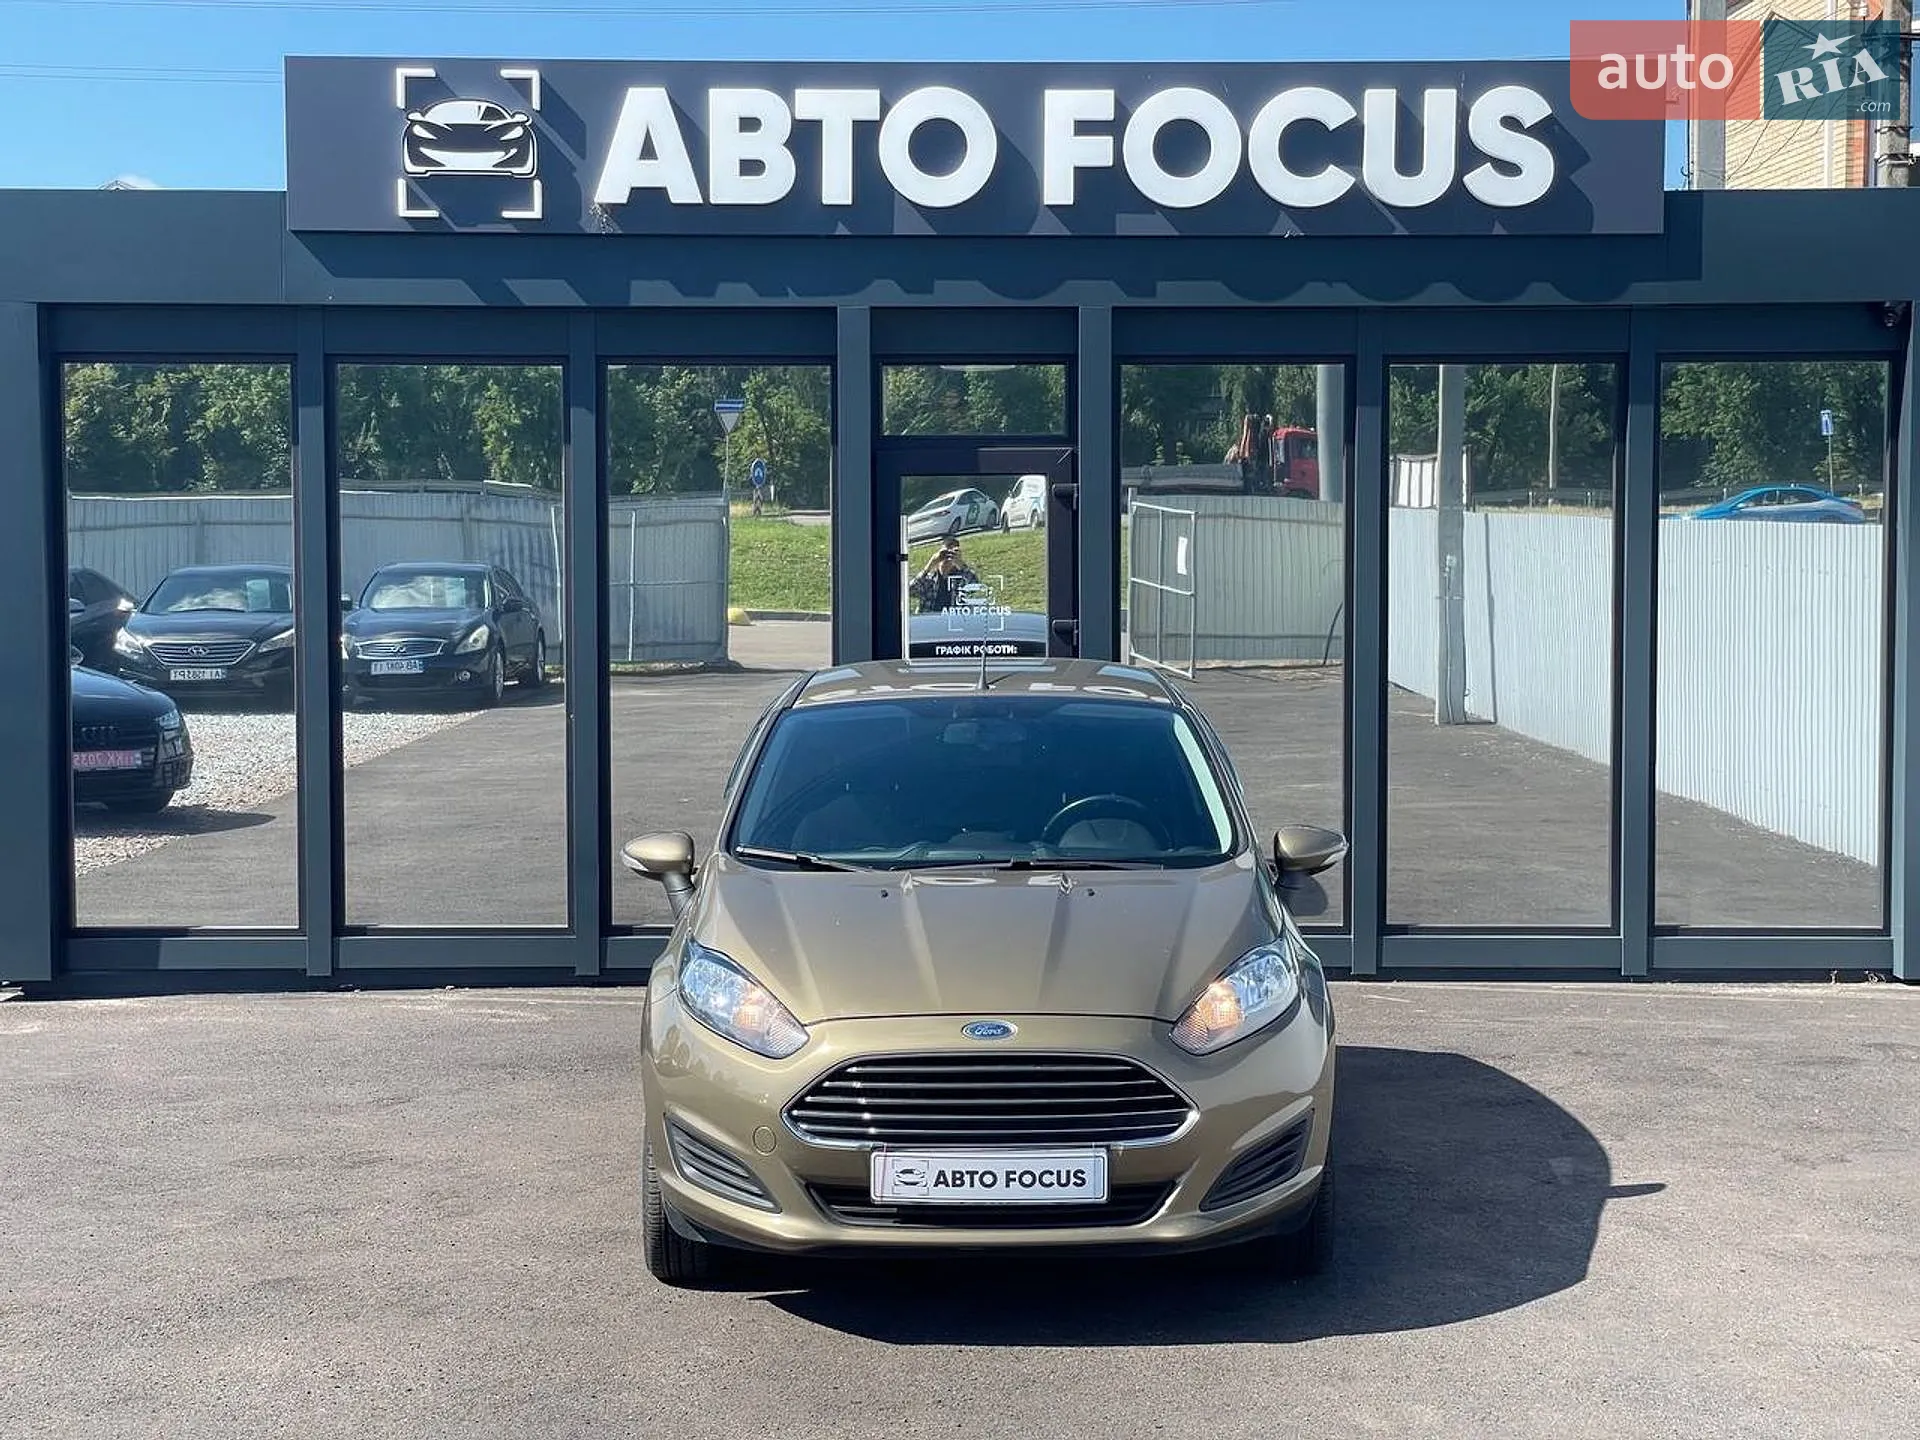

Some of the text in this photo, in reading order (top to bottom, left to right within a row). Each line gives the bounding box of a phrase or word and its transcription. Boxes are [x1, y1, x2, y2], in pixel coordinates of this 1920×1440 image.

[594, 85, 1555, 208] АВТО FOCUS
[935, 645, 972, 655] ГРАФІК
[974, 1024, 1005, 1037] Ford
[933, 1168, 1087, 1188] АВТО FOCUS
